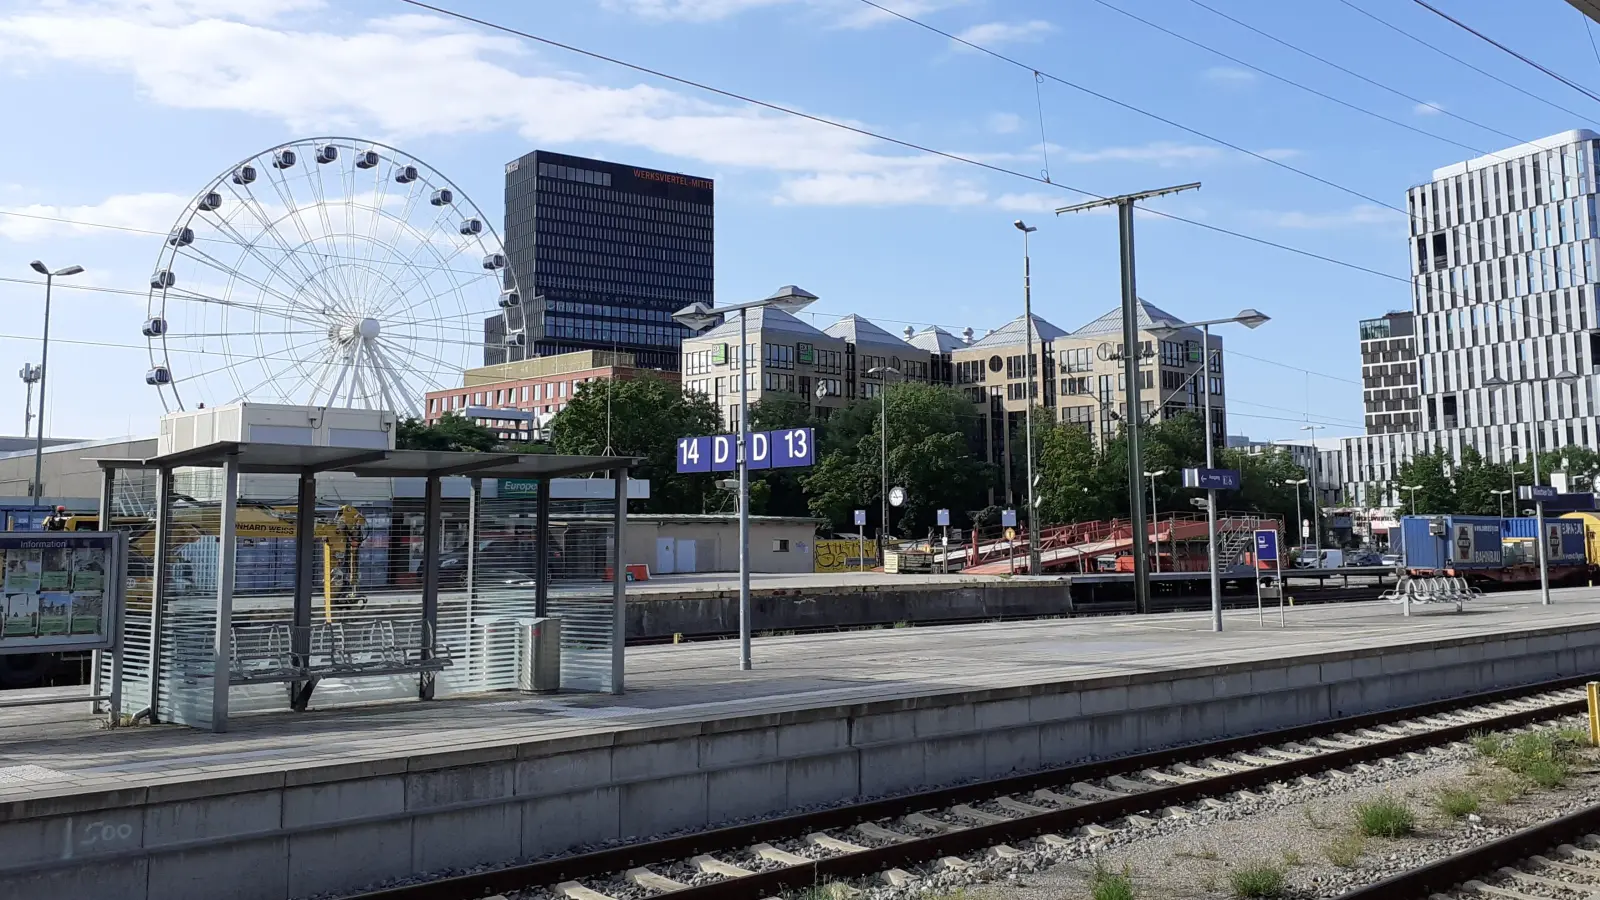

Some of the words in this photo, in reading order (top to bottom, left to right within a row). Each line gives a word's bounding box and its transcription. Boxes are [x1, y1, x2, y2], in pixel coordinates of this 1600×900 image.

[633, 168, 713, 190] WERKSVIERTEL-MITTE
[679, 438, 700, 465] 14
[714, 436, 729, 463] D
[753, 433, 768, 461] D
[784, 429, 808, 458] 13
[269, 525, 295, 535] WEISS
[20, 540, 67, 549] Information
[1475, 550, 1501, 563] BAHNBAU
